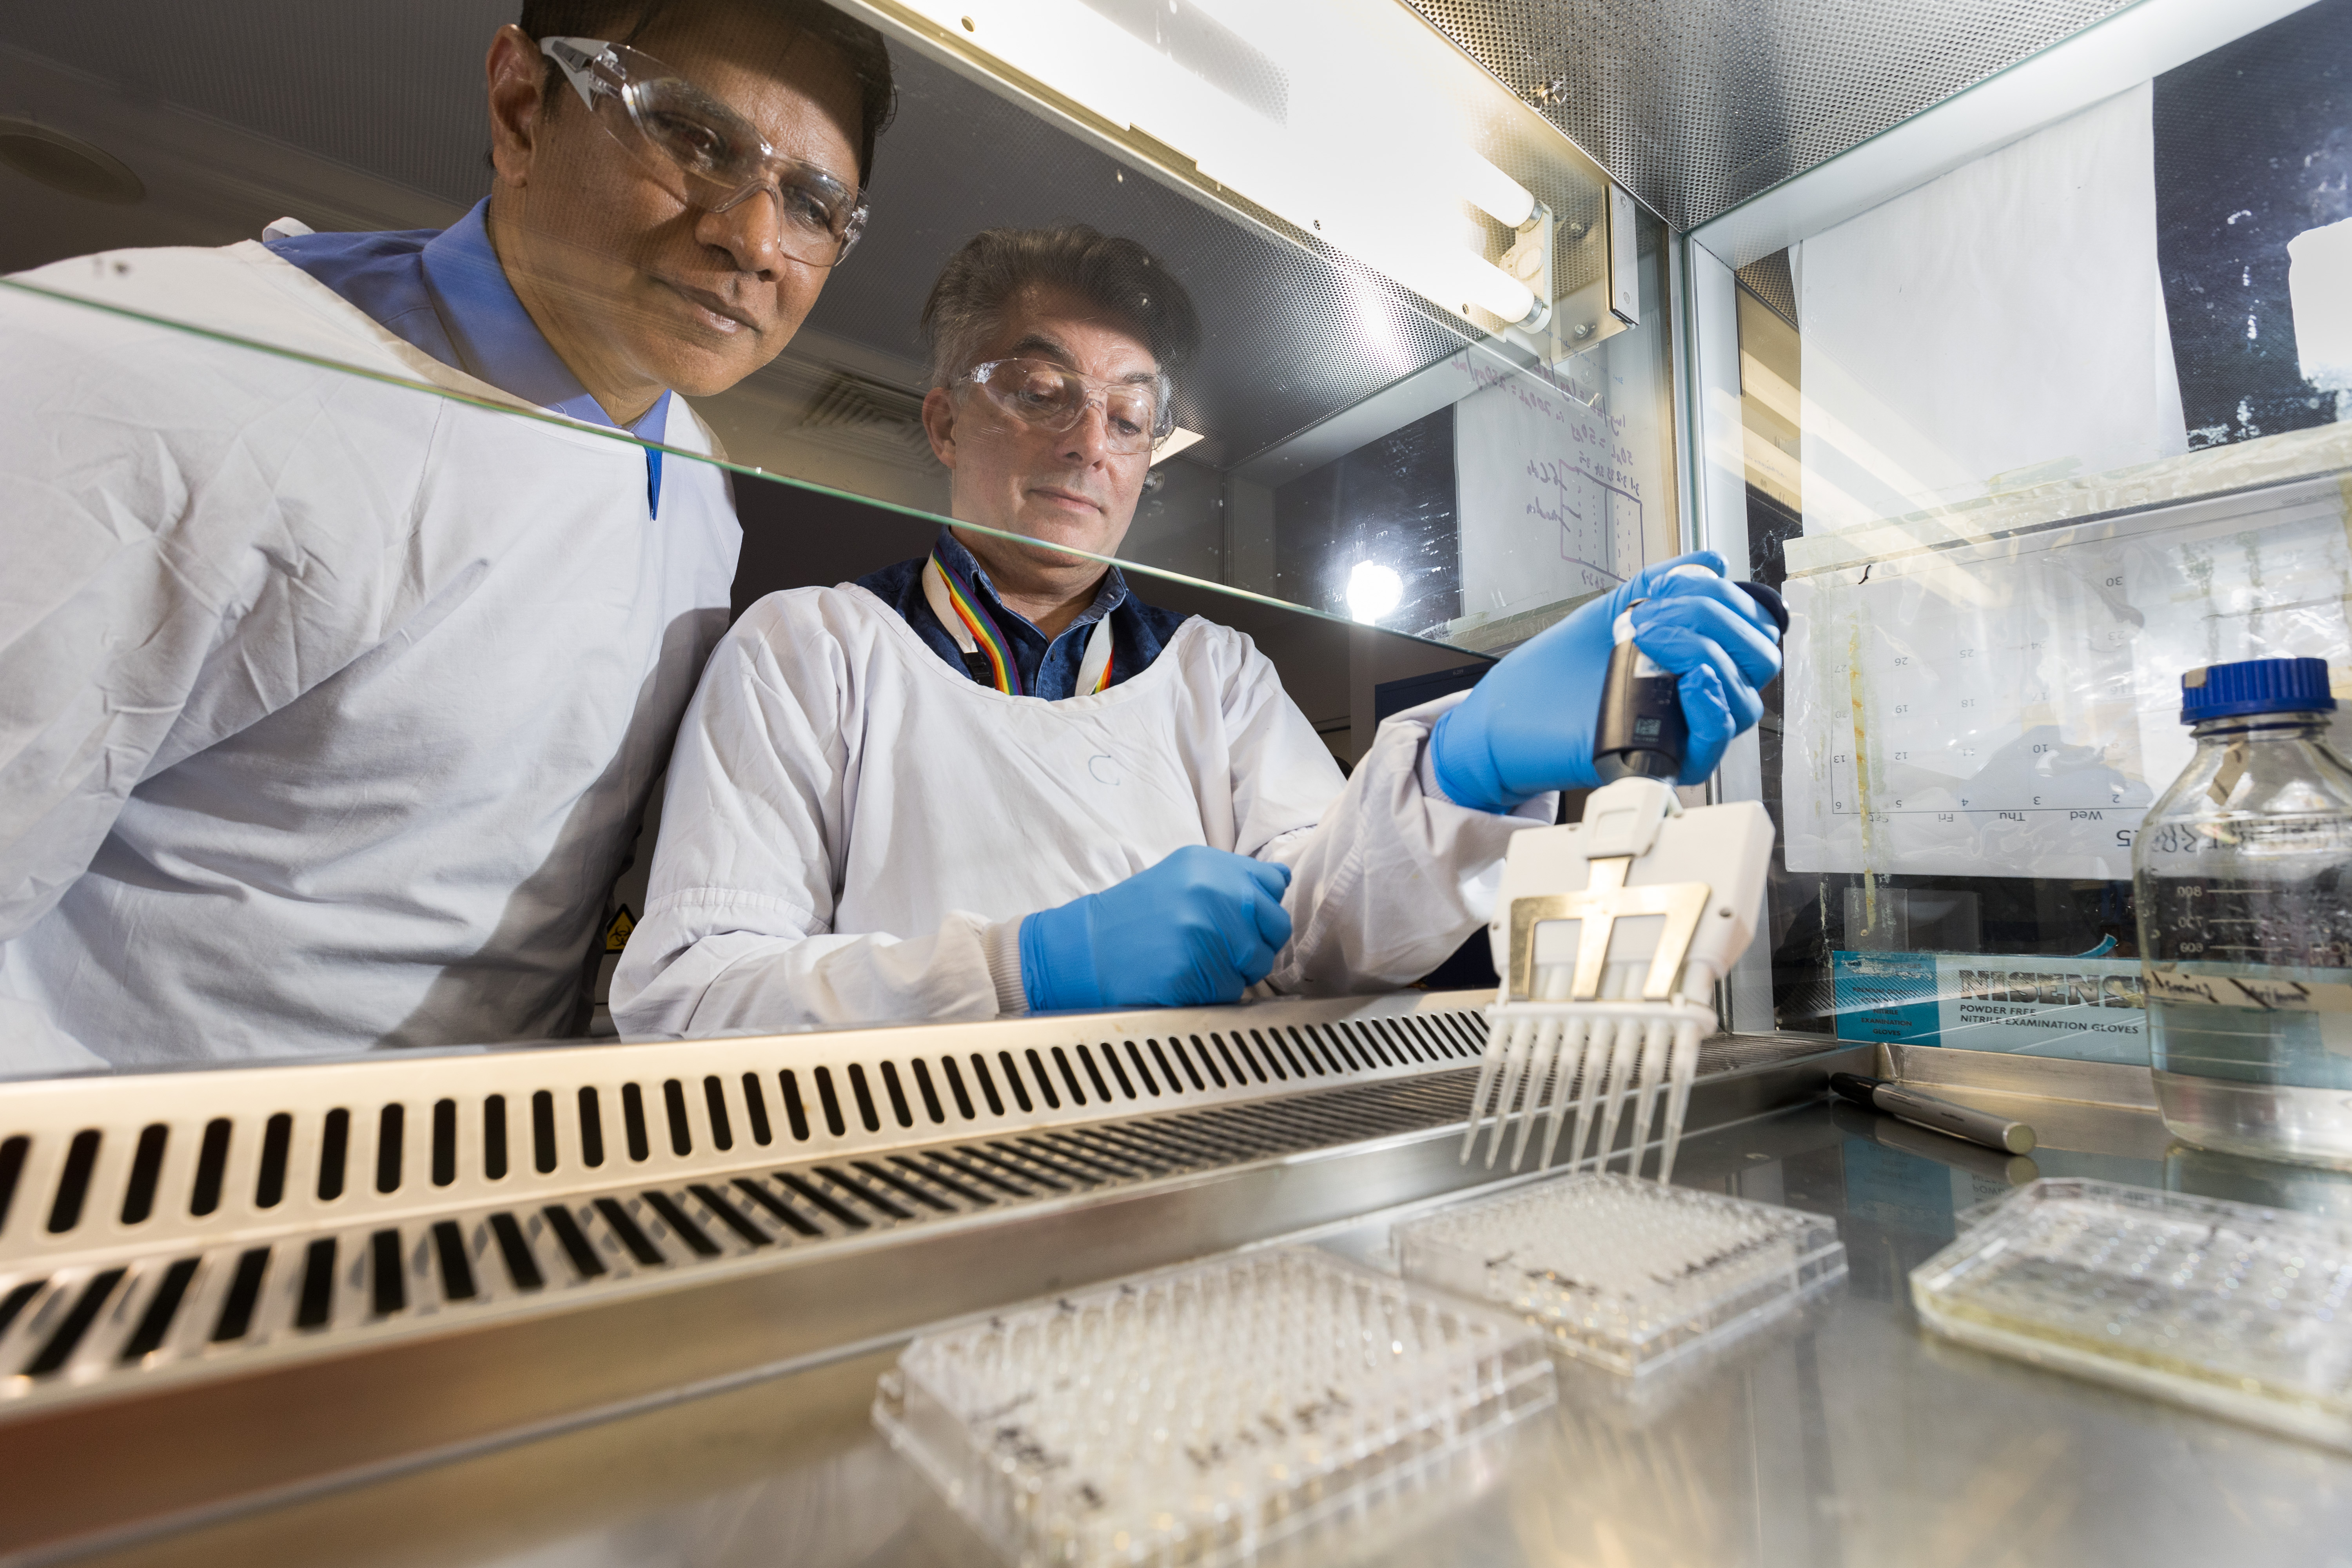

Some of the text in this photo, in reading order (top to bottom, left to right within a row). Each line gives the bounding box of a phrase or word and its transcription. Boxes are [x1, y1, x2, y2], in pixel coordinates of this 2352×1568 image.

[2106, 576, 2123, 587] 30
[1960, 649, 1974, 658] 25
[1895, 657, 1908, 666] 26
[1961, 699, 1975, 708] 18
[1895, 704, 1908, 713] 19
[2033, 744, 2048, 753] 10
[1834, 755, 1846, 763] 13
[1895, 752, 1908, 760] 12
[1961, 798, 1969, 806] 4
[2033, 796, 2041, 805] 3
[2112, 794, 2120, 803] 2
[1938, 813, 1954, 822] Fri
[2000, 812, 2026, 822] Thu
[2070, 810, 2103, 821] Wed
[1960, 1004, 2037, 1016] POWDER FREE
[1861, 1018, 1913, 1026] EXAMINATION
[2005, 1018, 2088, 1031] EXAMINATION
[2091, 1024, 2139, 1034] GLOVES
